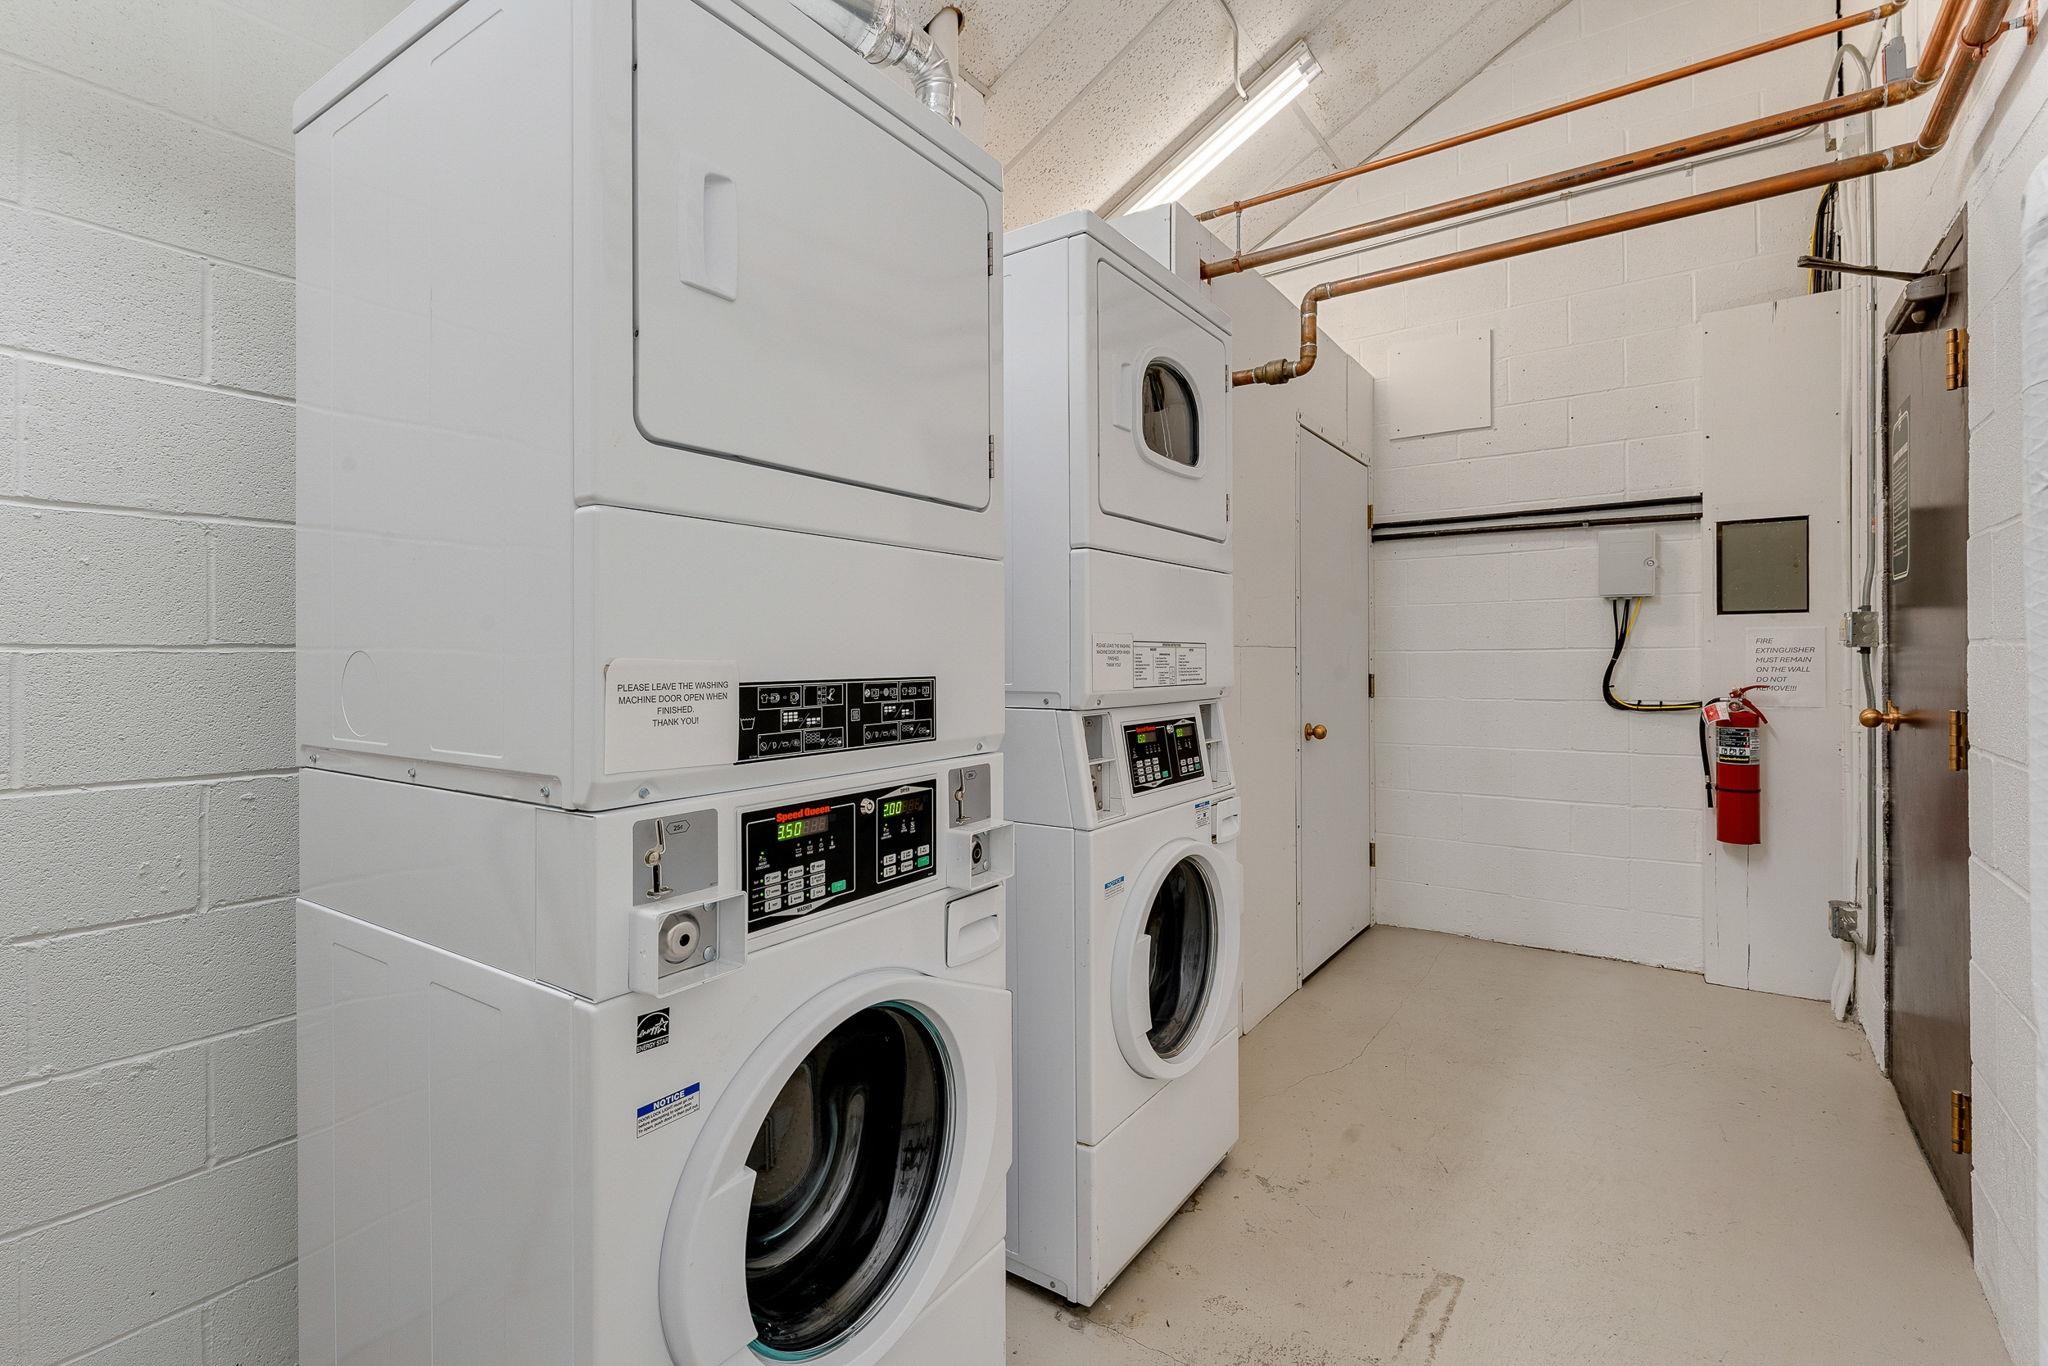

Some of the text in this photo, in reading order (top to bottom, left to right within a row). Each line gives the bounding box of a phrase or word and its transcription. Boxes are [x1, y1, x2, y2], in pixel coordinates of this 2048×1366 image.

[618, 681, 728, 692] PLEASE LEAVE THE WASHING
[619, 696, 656, 704] MACHINE
[659, 695, 682, 703] DOOR
[684, 694, 704, 702] OPEN
[657, 706, 694, 714] FINISHED.
[653, 717, 699, 727] THANK YOU!
[776, 806, 830, 822] Speed Queen
[797, 904, 812, 912] WASHER
[636, 1041, 656, 1052] ENERGY
[653, 1090, 685, 1110] NOTICE
